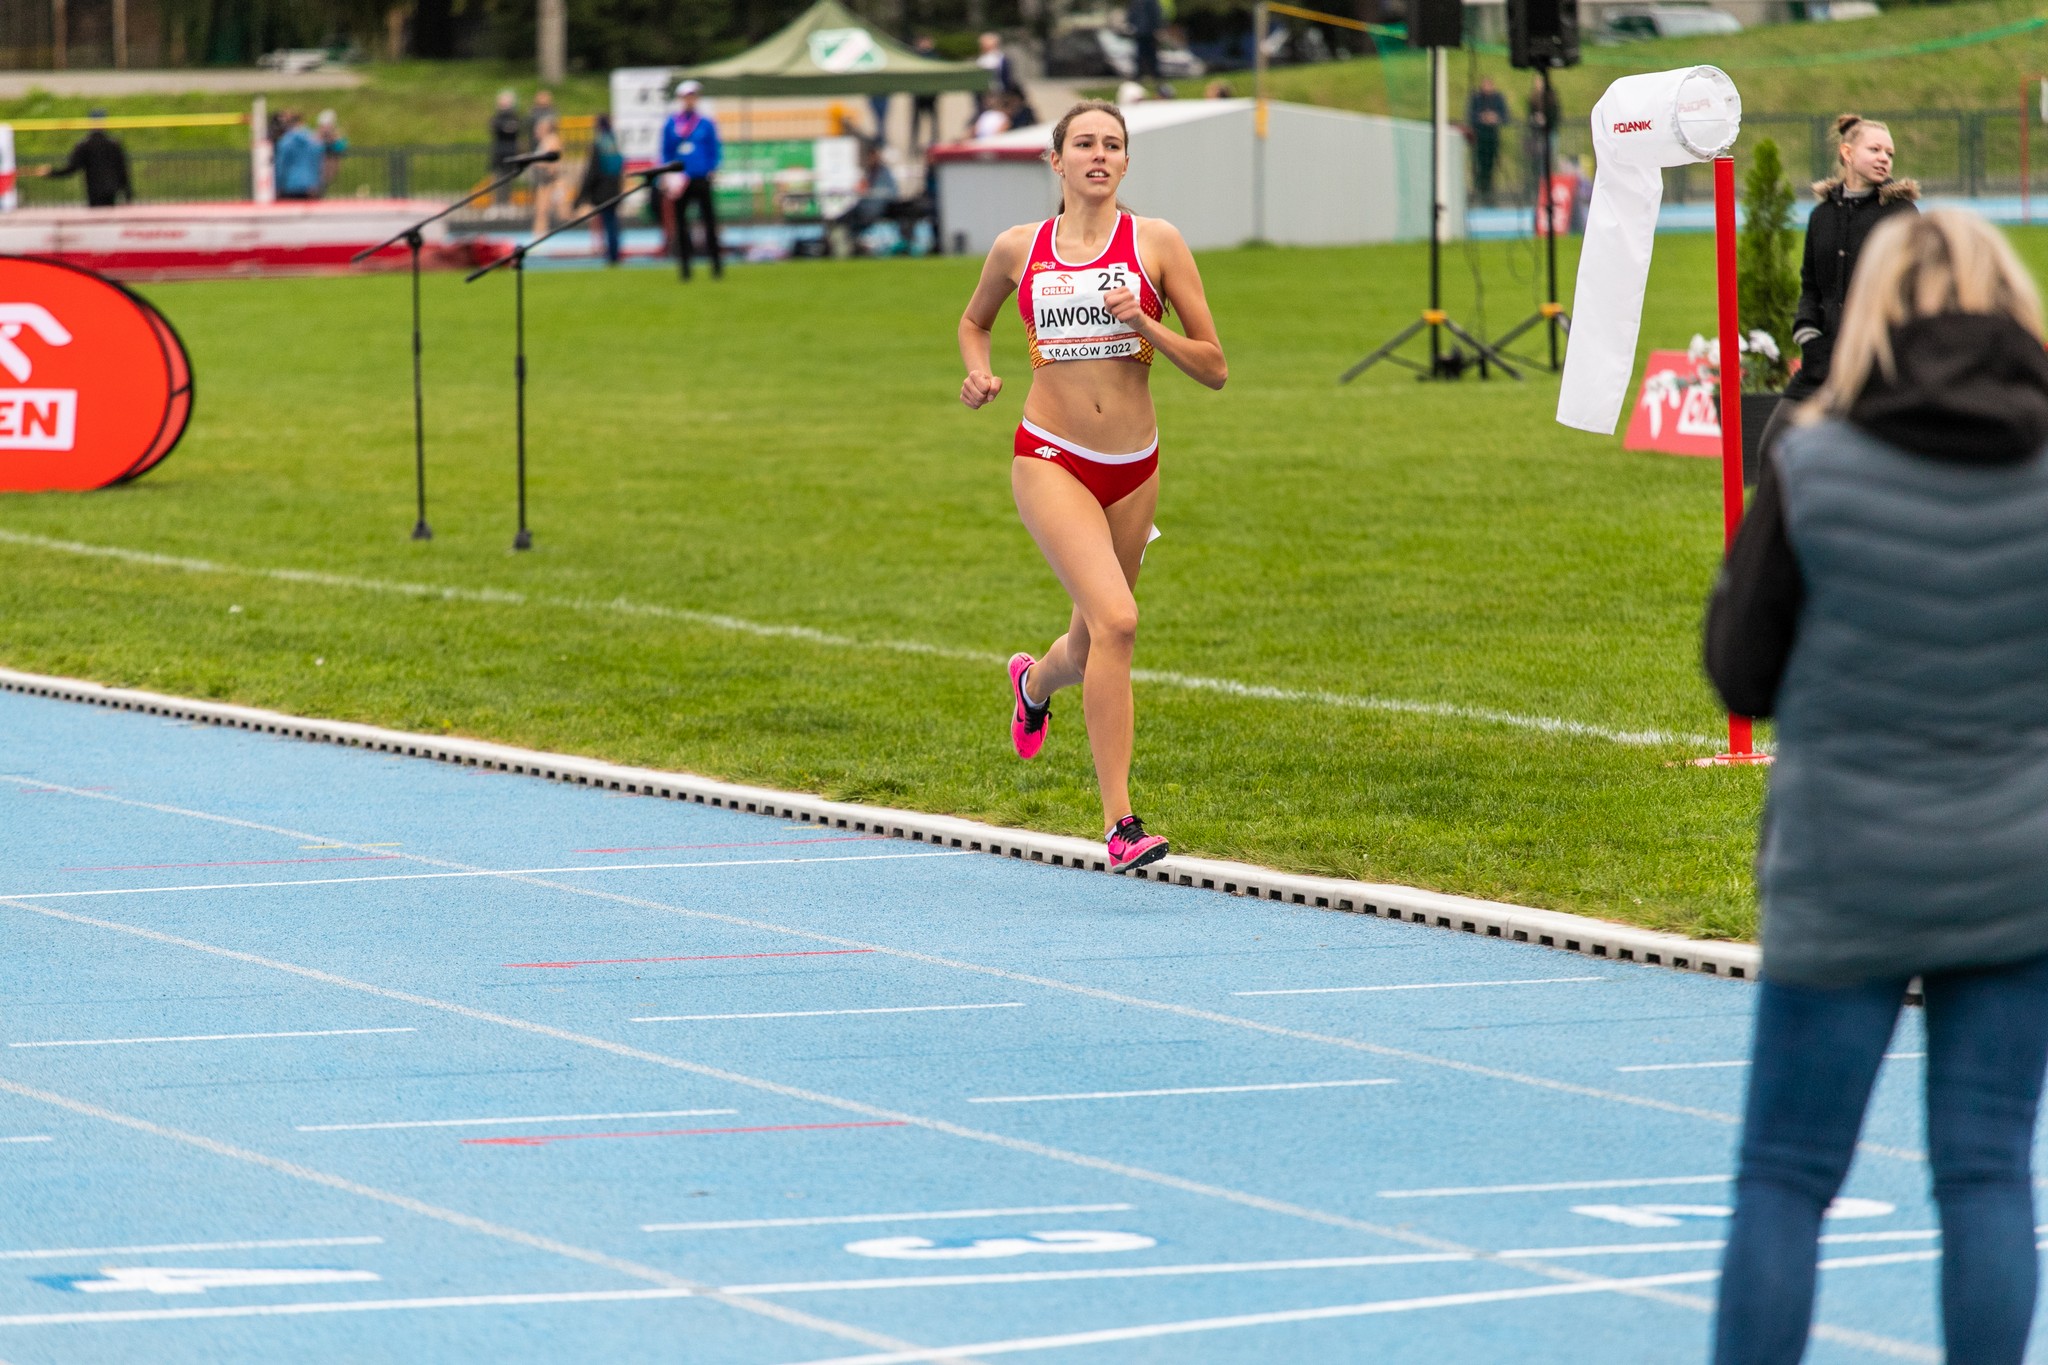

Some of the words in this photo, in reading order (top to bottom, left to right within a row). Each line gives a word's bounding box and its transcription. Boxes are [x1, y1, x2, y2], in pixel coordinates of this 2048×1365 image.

[1613, 119, 1652, 133] POLANIK
[1098, 272, 1126, 291] 25
[1043, 286, 1073, 295] ORLEN
[1049, 344, 1100, 358] KRAKÓW
[1104, 342, 1131, 355] 2022
[1034, 445, 1061, 459] 4F
[843, 1230, 1158, 1260] 3
[72, 1267, 382, 1293] 4
